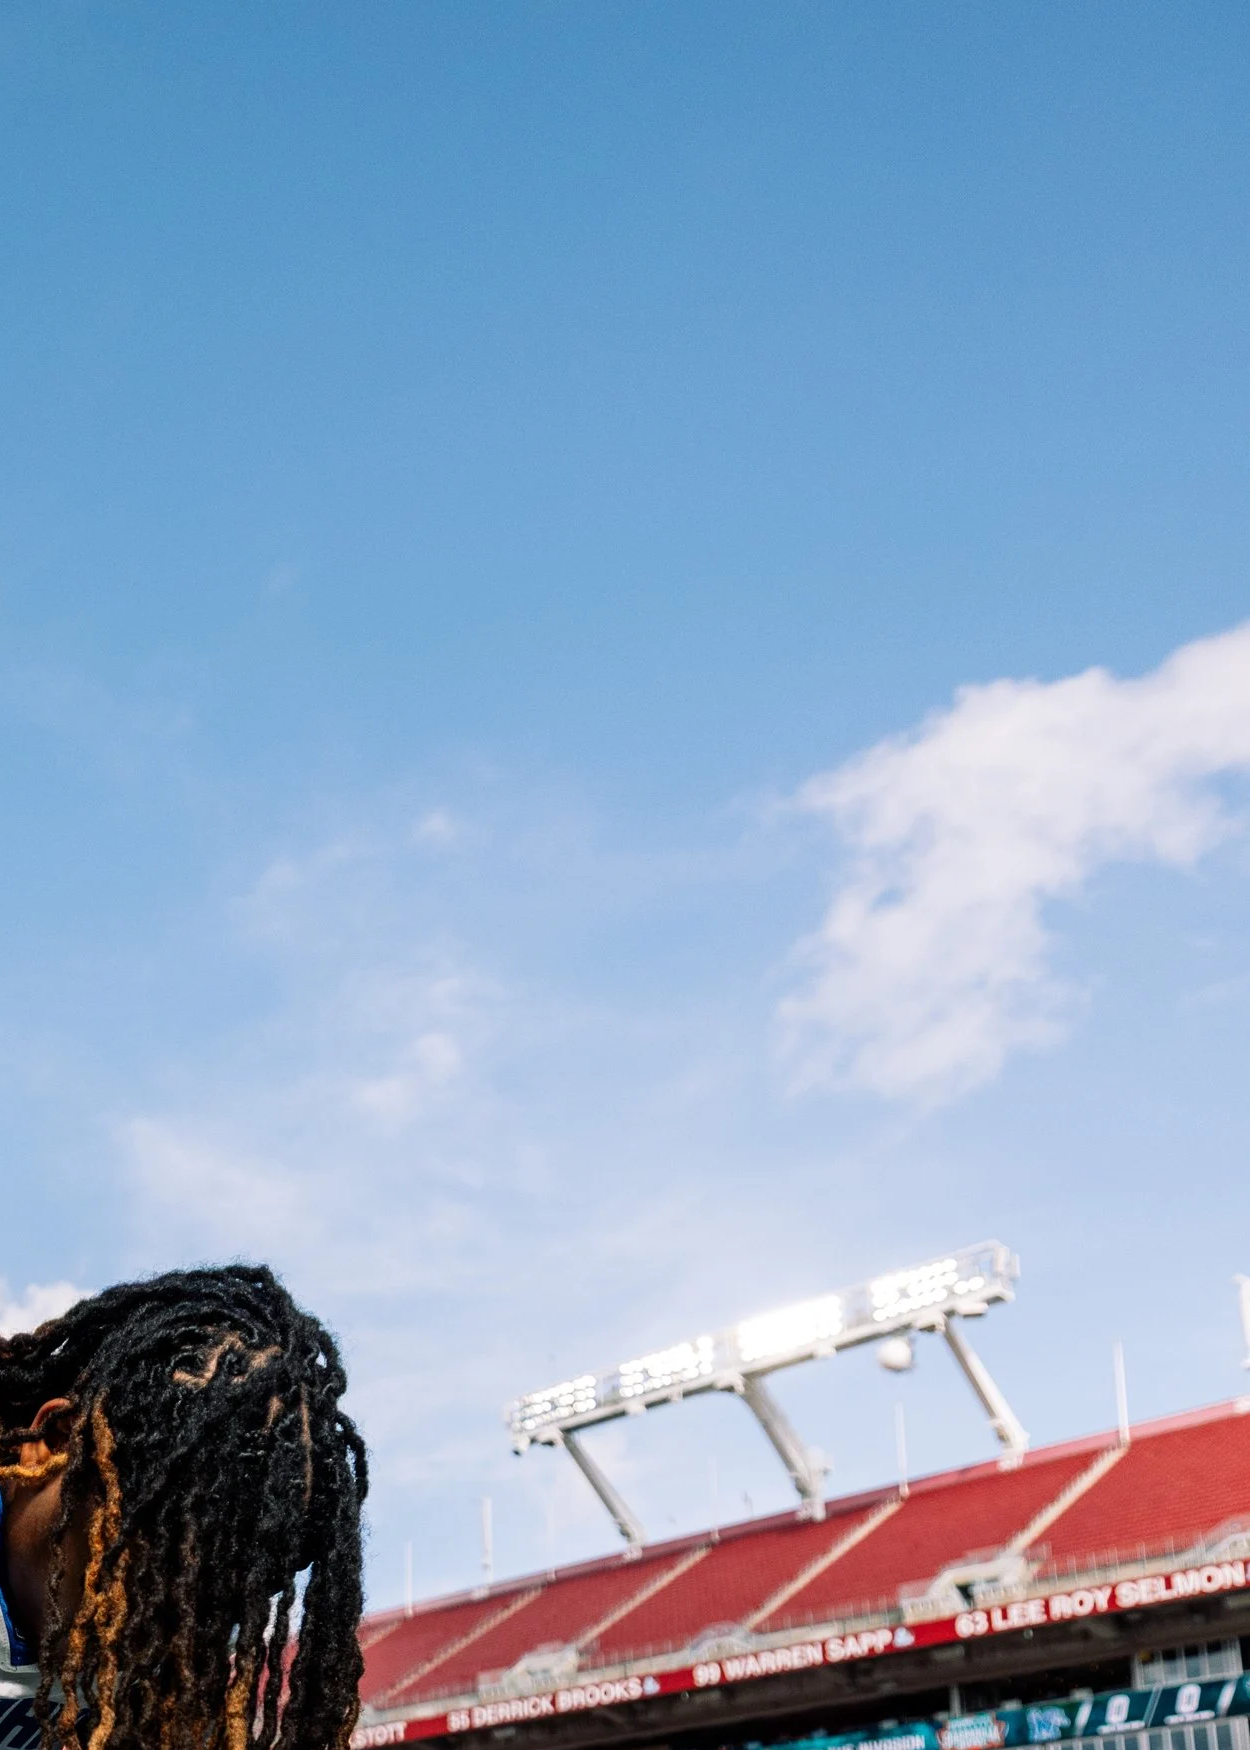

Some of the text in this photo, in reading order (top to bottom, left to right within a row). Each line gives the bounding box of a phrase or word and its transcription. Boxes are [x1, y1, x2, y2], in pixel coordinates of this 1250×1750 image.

[954, 1561, 1247, 1638] 63 LEE ROY SELMON
[692, 1629, 893, 1688] 99 WARREN SAPP
[446, 1676, 643, 1733] 55 DERRICK BROOKS
[1105, 1693, 1130, 1724] 0
[1175, 1683, 1201, 1714] 0
[352, 1722, 408, 1750] STOTT
